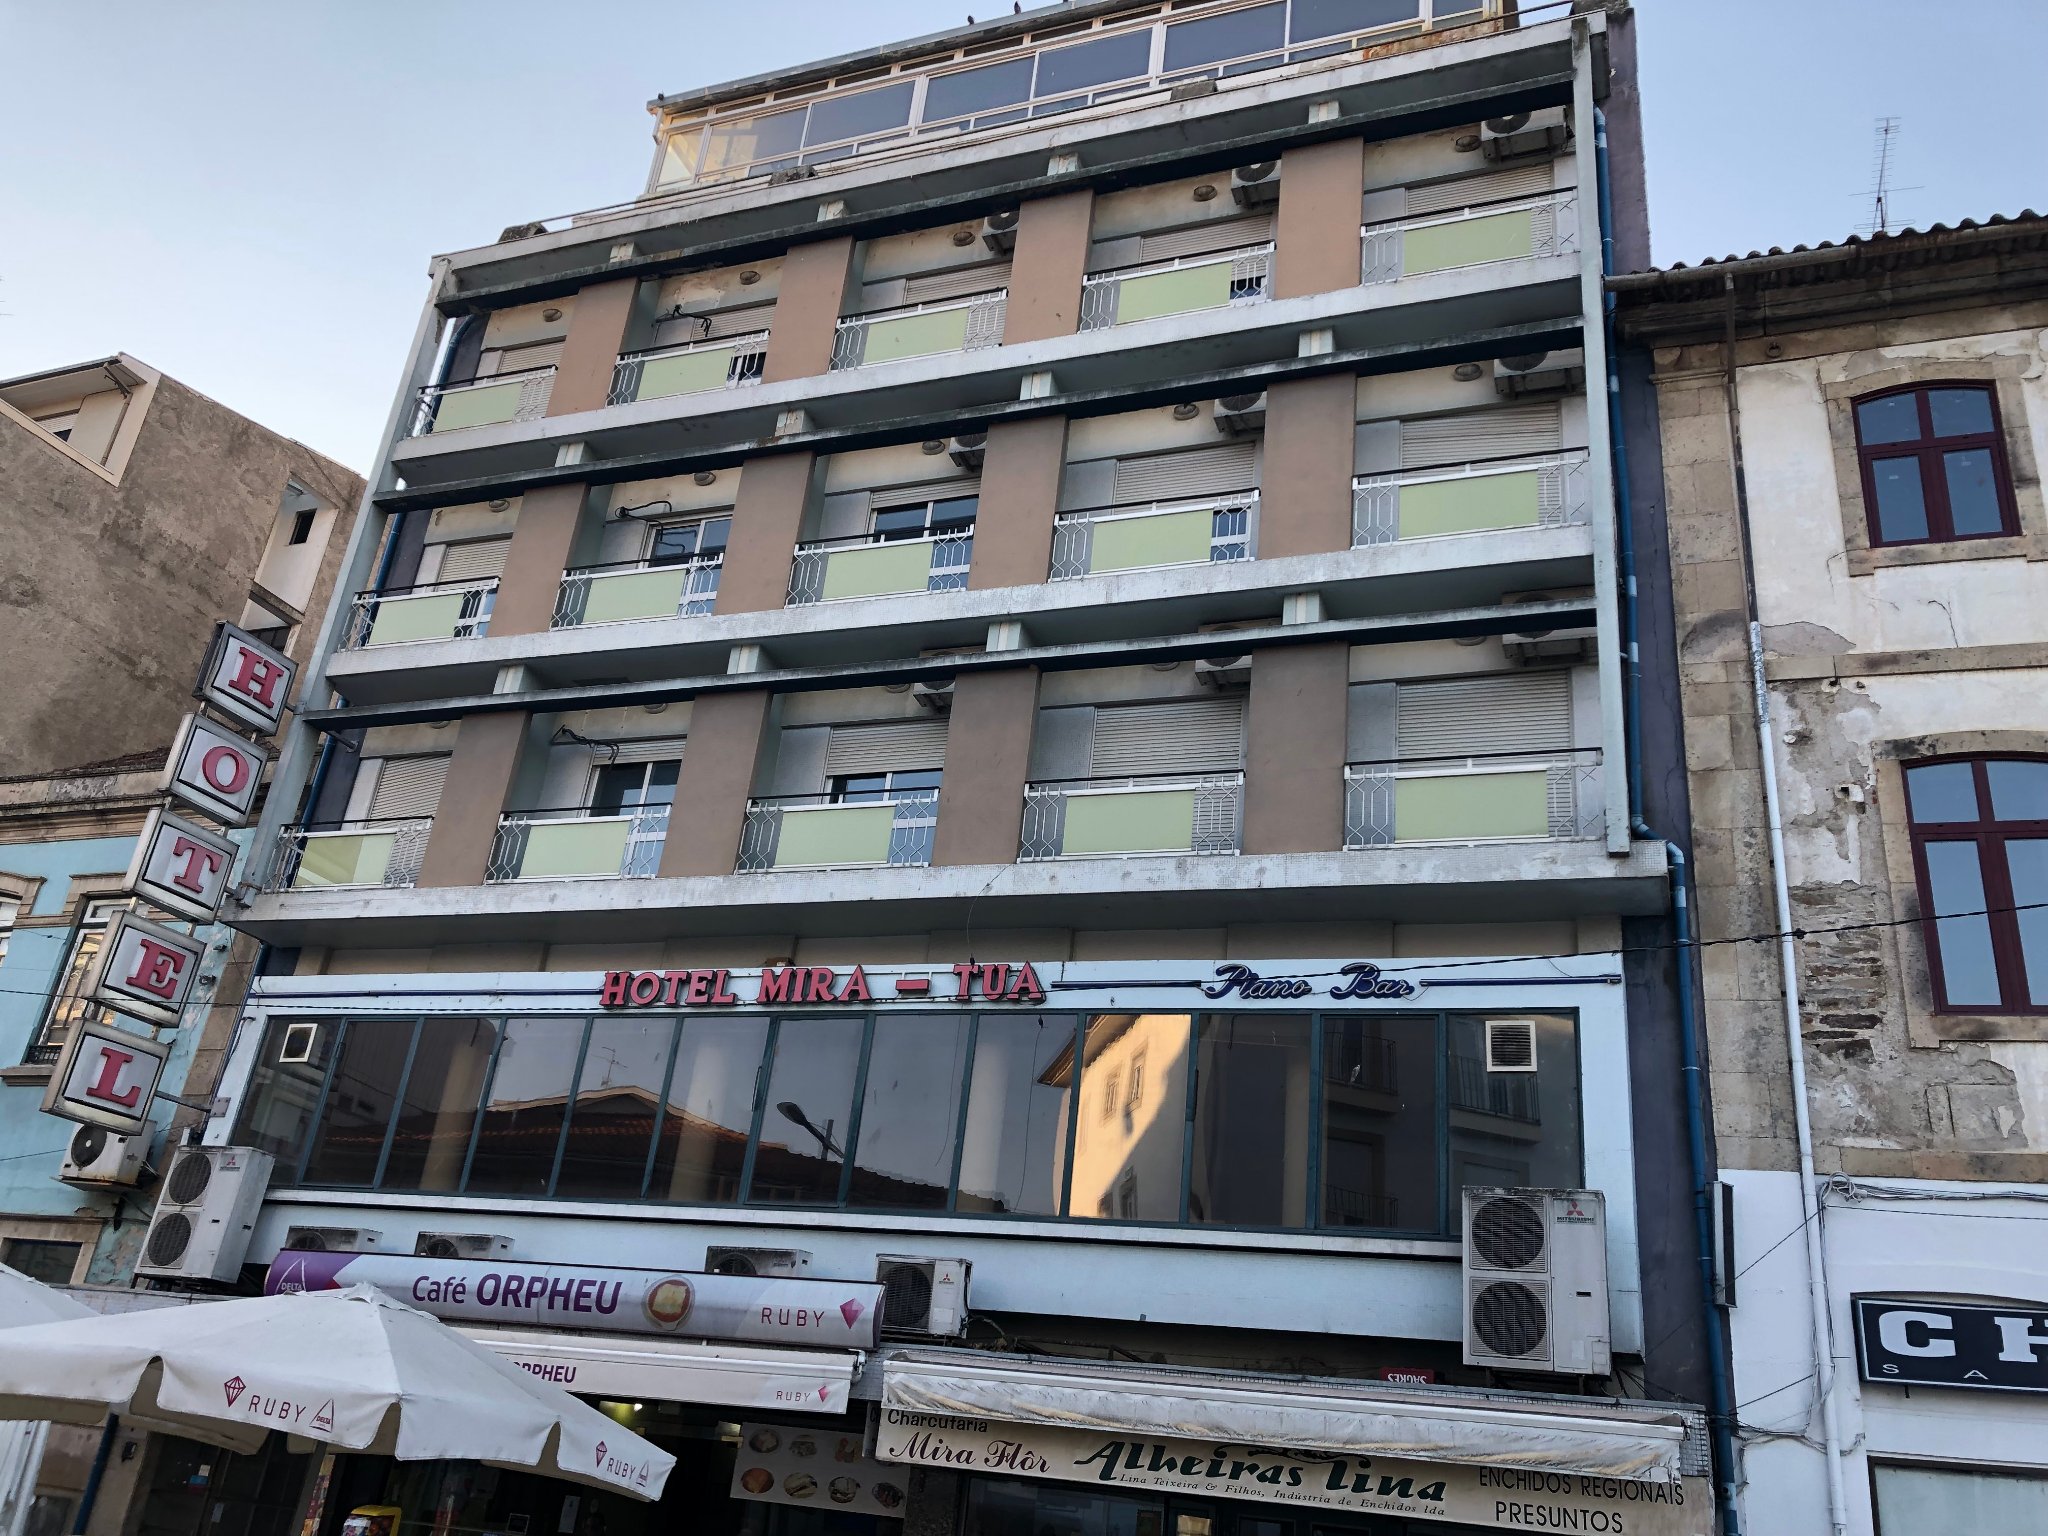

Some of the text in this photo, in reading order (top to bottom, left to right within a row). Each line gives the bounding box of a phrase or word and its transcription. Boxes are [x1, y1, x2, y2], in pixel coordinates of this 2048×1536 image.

[87, 646, 285, 1107] HOTEL
[599, 969, 738, 1006] HOTEL
[756, 964, 872, 1004] MIRA
[953, 960, 1044, 1003] TUA
[1205, 962, 1415, 1000] Piano Bar
[281, 1282, 302, 1291] DELTA
[412, 1273, 623, 1315] Café ORPHEU
[761, 1307, 825, 1328] RUBY
[248, 1394, 307, 1423] RUBY
[776, 1390, 811, 1402] RUBY
[315, 1415, 331, 1425] DELTA
[887, 1408, 988, 1433] Charcutaria
[606, 1457, 637, 1480] RUBY
[889, 1431, 1051, 1473] Mira Flôr
[1073, 1440, 1304, 1487] Alheiras
[1119, 1473, 1147, 1485] Lina
[1153, 1476, 1199, 1490] Teixeira
[1205, 1482, 1218, 1491] &
[1224, 1484, 1266, 1498] Filhos,
[1273, 1489, 1331, 1504] Indústria
[1338, 1496, 1352, 1506] de
[1359, 1498, 1417, 1513] Enchidos
[1479, 1466, 1685, 1506] ENCHIDOS REGIONAIS
[1495, 1500, 1623, 1534] PRESUNTOS
